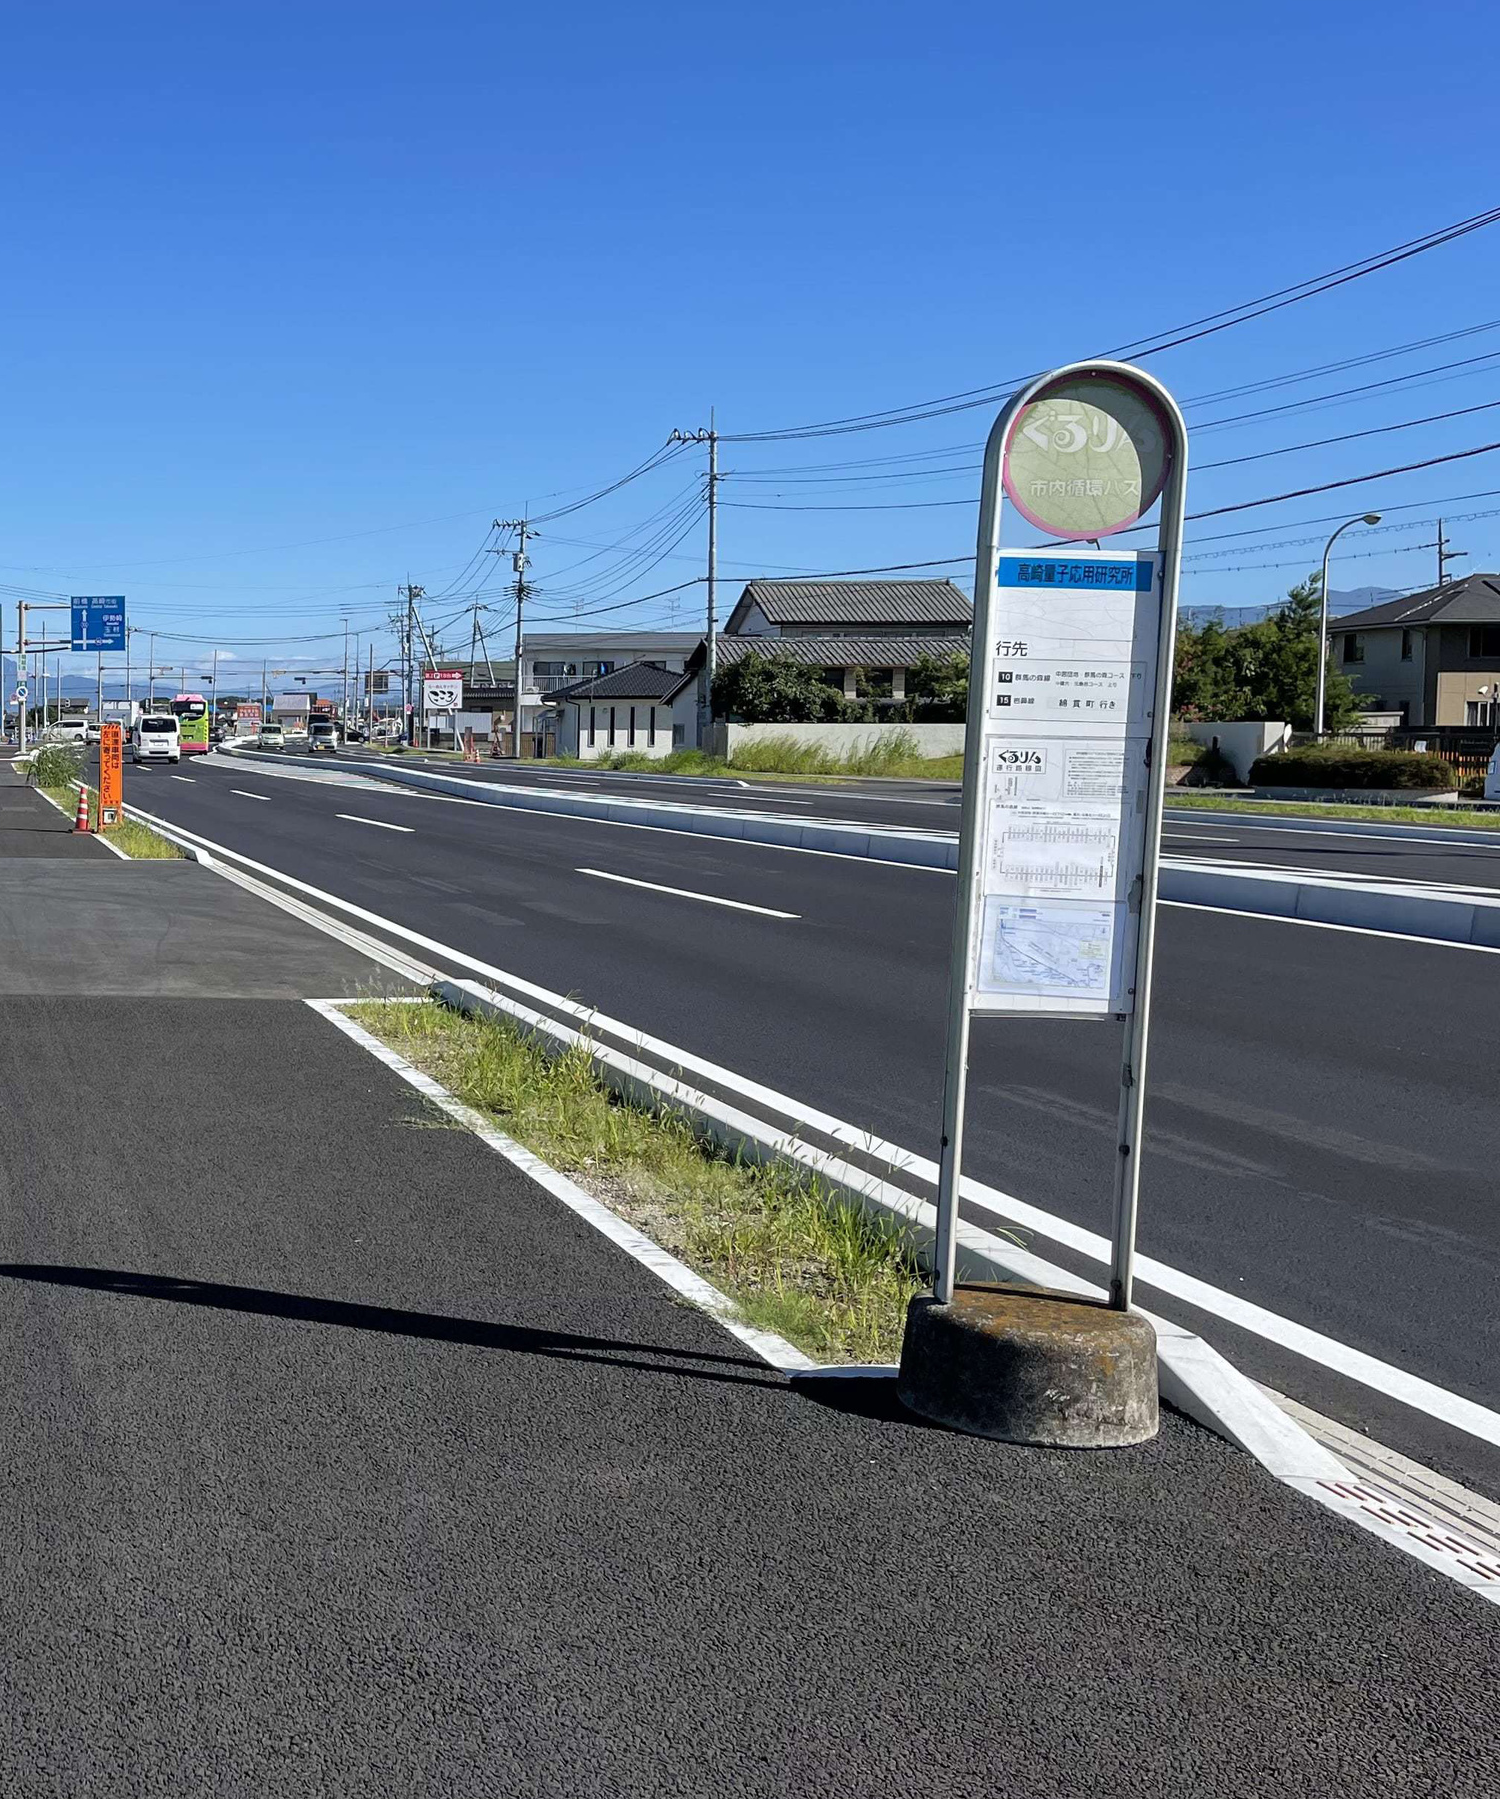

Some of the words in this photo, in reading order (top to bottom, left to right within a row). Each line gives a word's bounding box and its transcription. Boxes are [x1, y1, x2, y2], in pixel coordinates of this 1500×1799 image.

[1018, 563, 1134, 585] 高崎量子応用研究所
[995, 640, 1028, 657] 行先
[998, 749, 1042, 764] ぐるりん
